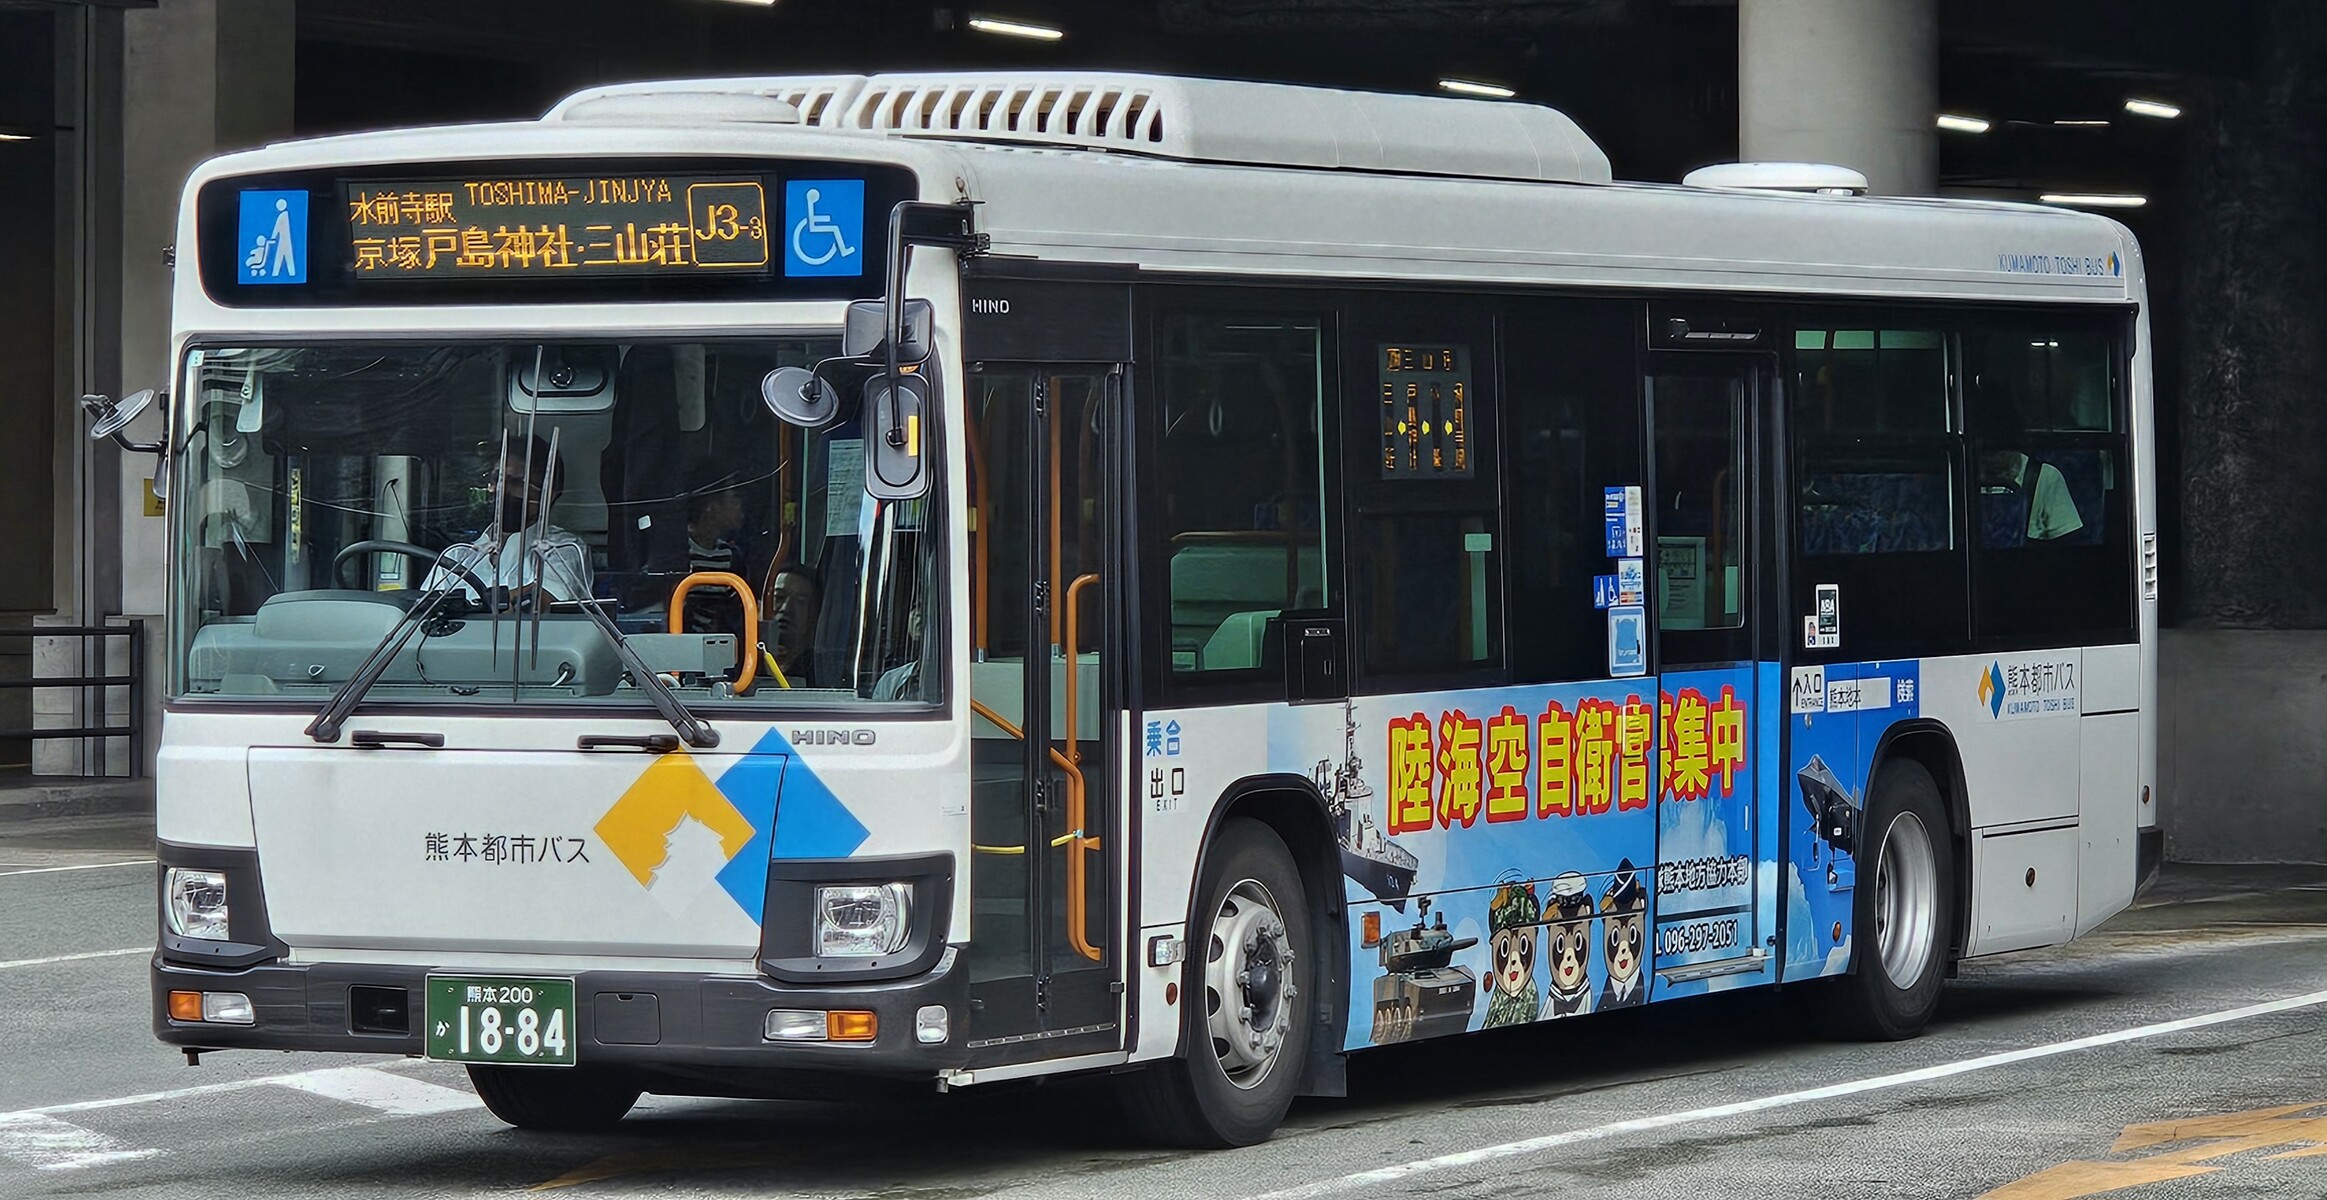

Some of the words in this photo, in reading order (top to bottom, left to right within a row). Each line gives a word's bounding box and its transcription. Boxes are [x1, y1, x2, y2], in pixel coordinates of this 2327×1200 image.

[348, 191, 457, 225] 水前寺駅
[463, 178, 672, 207] TOSHIMA-JINJYA
[694, 203, 764, 241] J3-3
[352, 235, 422, 271] 京塚
[972, 298, 1010, 314] HINO
[1803, 673, 1822, 694] 入口
[2006, 662, 2075, 697] 熊本都市バス
[792, 729, 876, 745] HINO
[1146, 719, 1182, 757] 乗合
[1150, 767, 1185, 799] 出口
[1156, 797, 1178, 812] EXIT
[425, 832, 590, 866] 熊本都市バス
[1664, 919, 1738, 955] 096-297-2051
[466, 985, 533, 1004] 熊本200
[435, 1019, 450, 1038] か
[460, 1005, 566, 1057] 18-84
